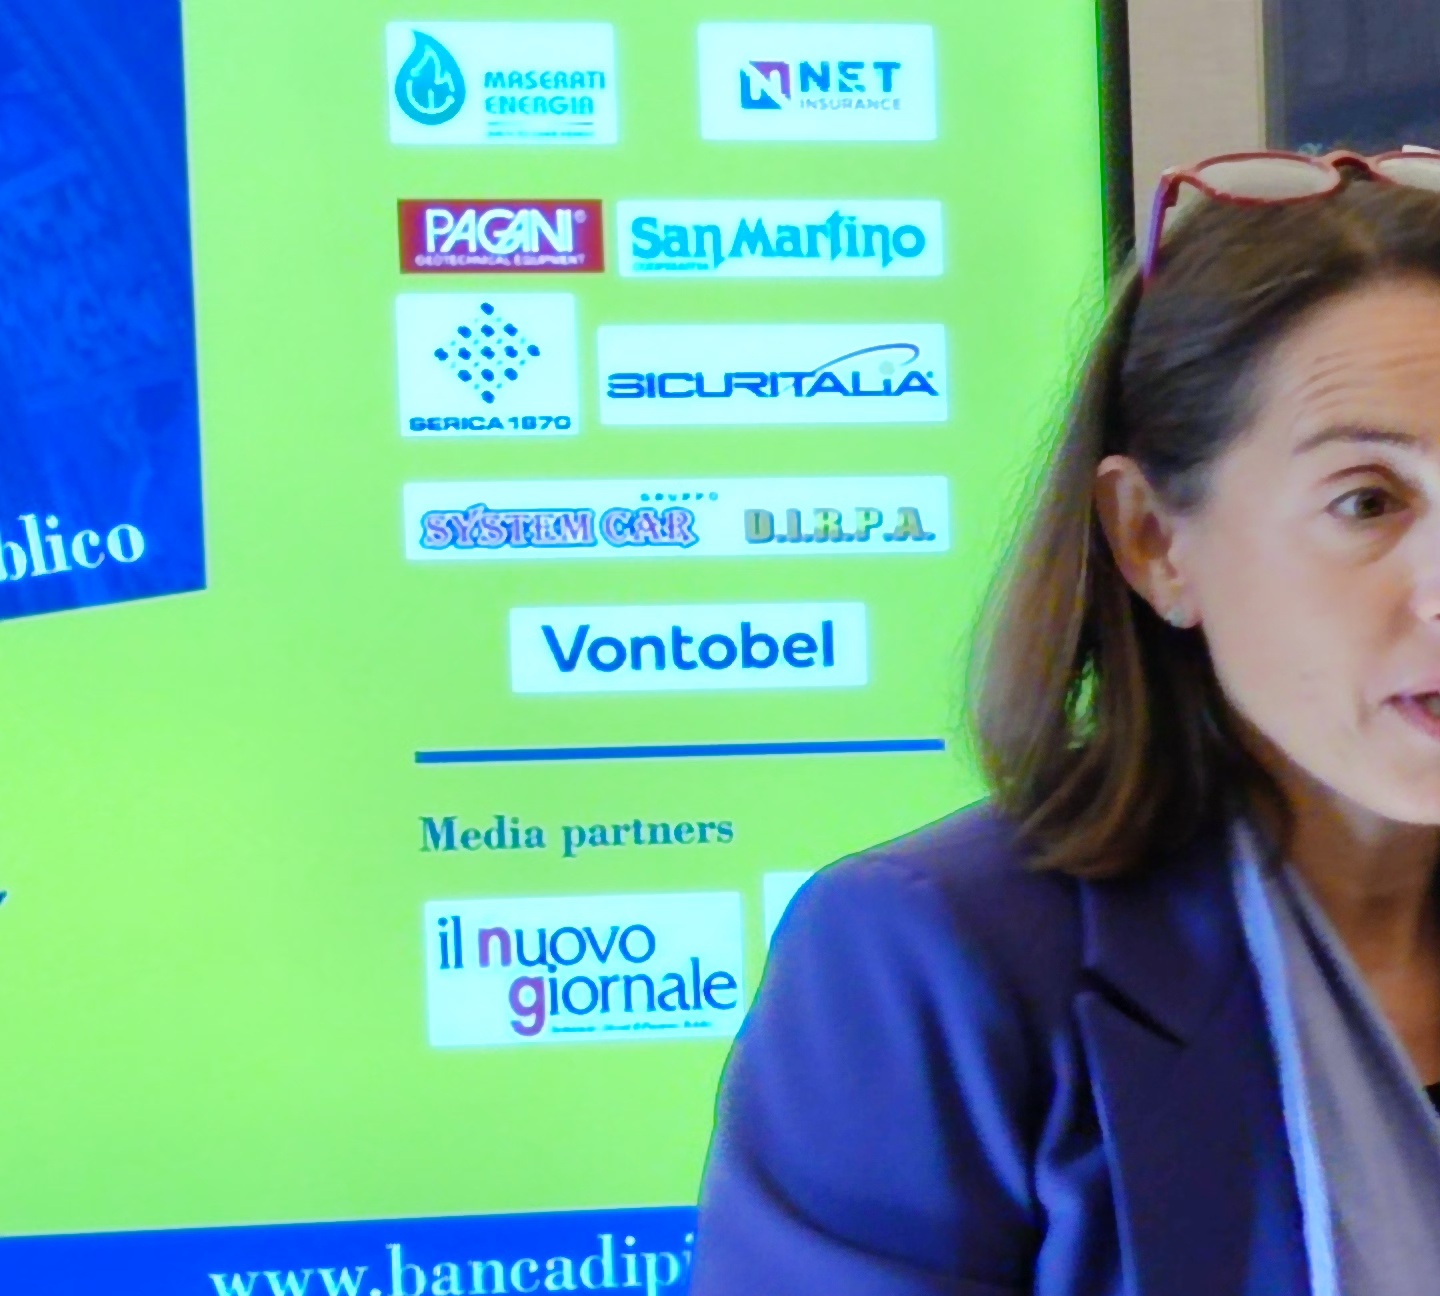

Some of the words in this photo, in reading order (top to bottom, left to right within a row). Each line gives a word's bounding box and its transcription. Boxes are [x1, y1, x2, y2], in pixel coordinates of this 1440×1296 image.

[484, 71, 605, 90] MASERATI
[800, 61, 900, 92] NET
[485, 95, 593, 115] ENERGIA
[800, 98, 901, 111] INSURANCE
[631, 216, 721, 267] San
[728, 210, 925, 267] Martino
[606, 370, 939, 399] SICURITALIA
[420, 504, 597, 549] SYSTEM
[600, 507, 699, 548] CAR
[744, 507, 936, 545] D.I.R.P.A.
[541, 619, 835, 675] Vontobel
[418, 814, 546, 853] Media
[560, 812, 735, 858] partners
[437, 915, 465, 971] il
[477, 919, 656, 971] nuovo
[508, 956, 738, 1037] giornale
